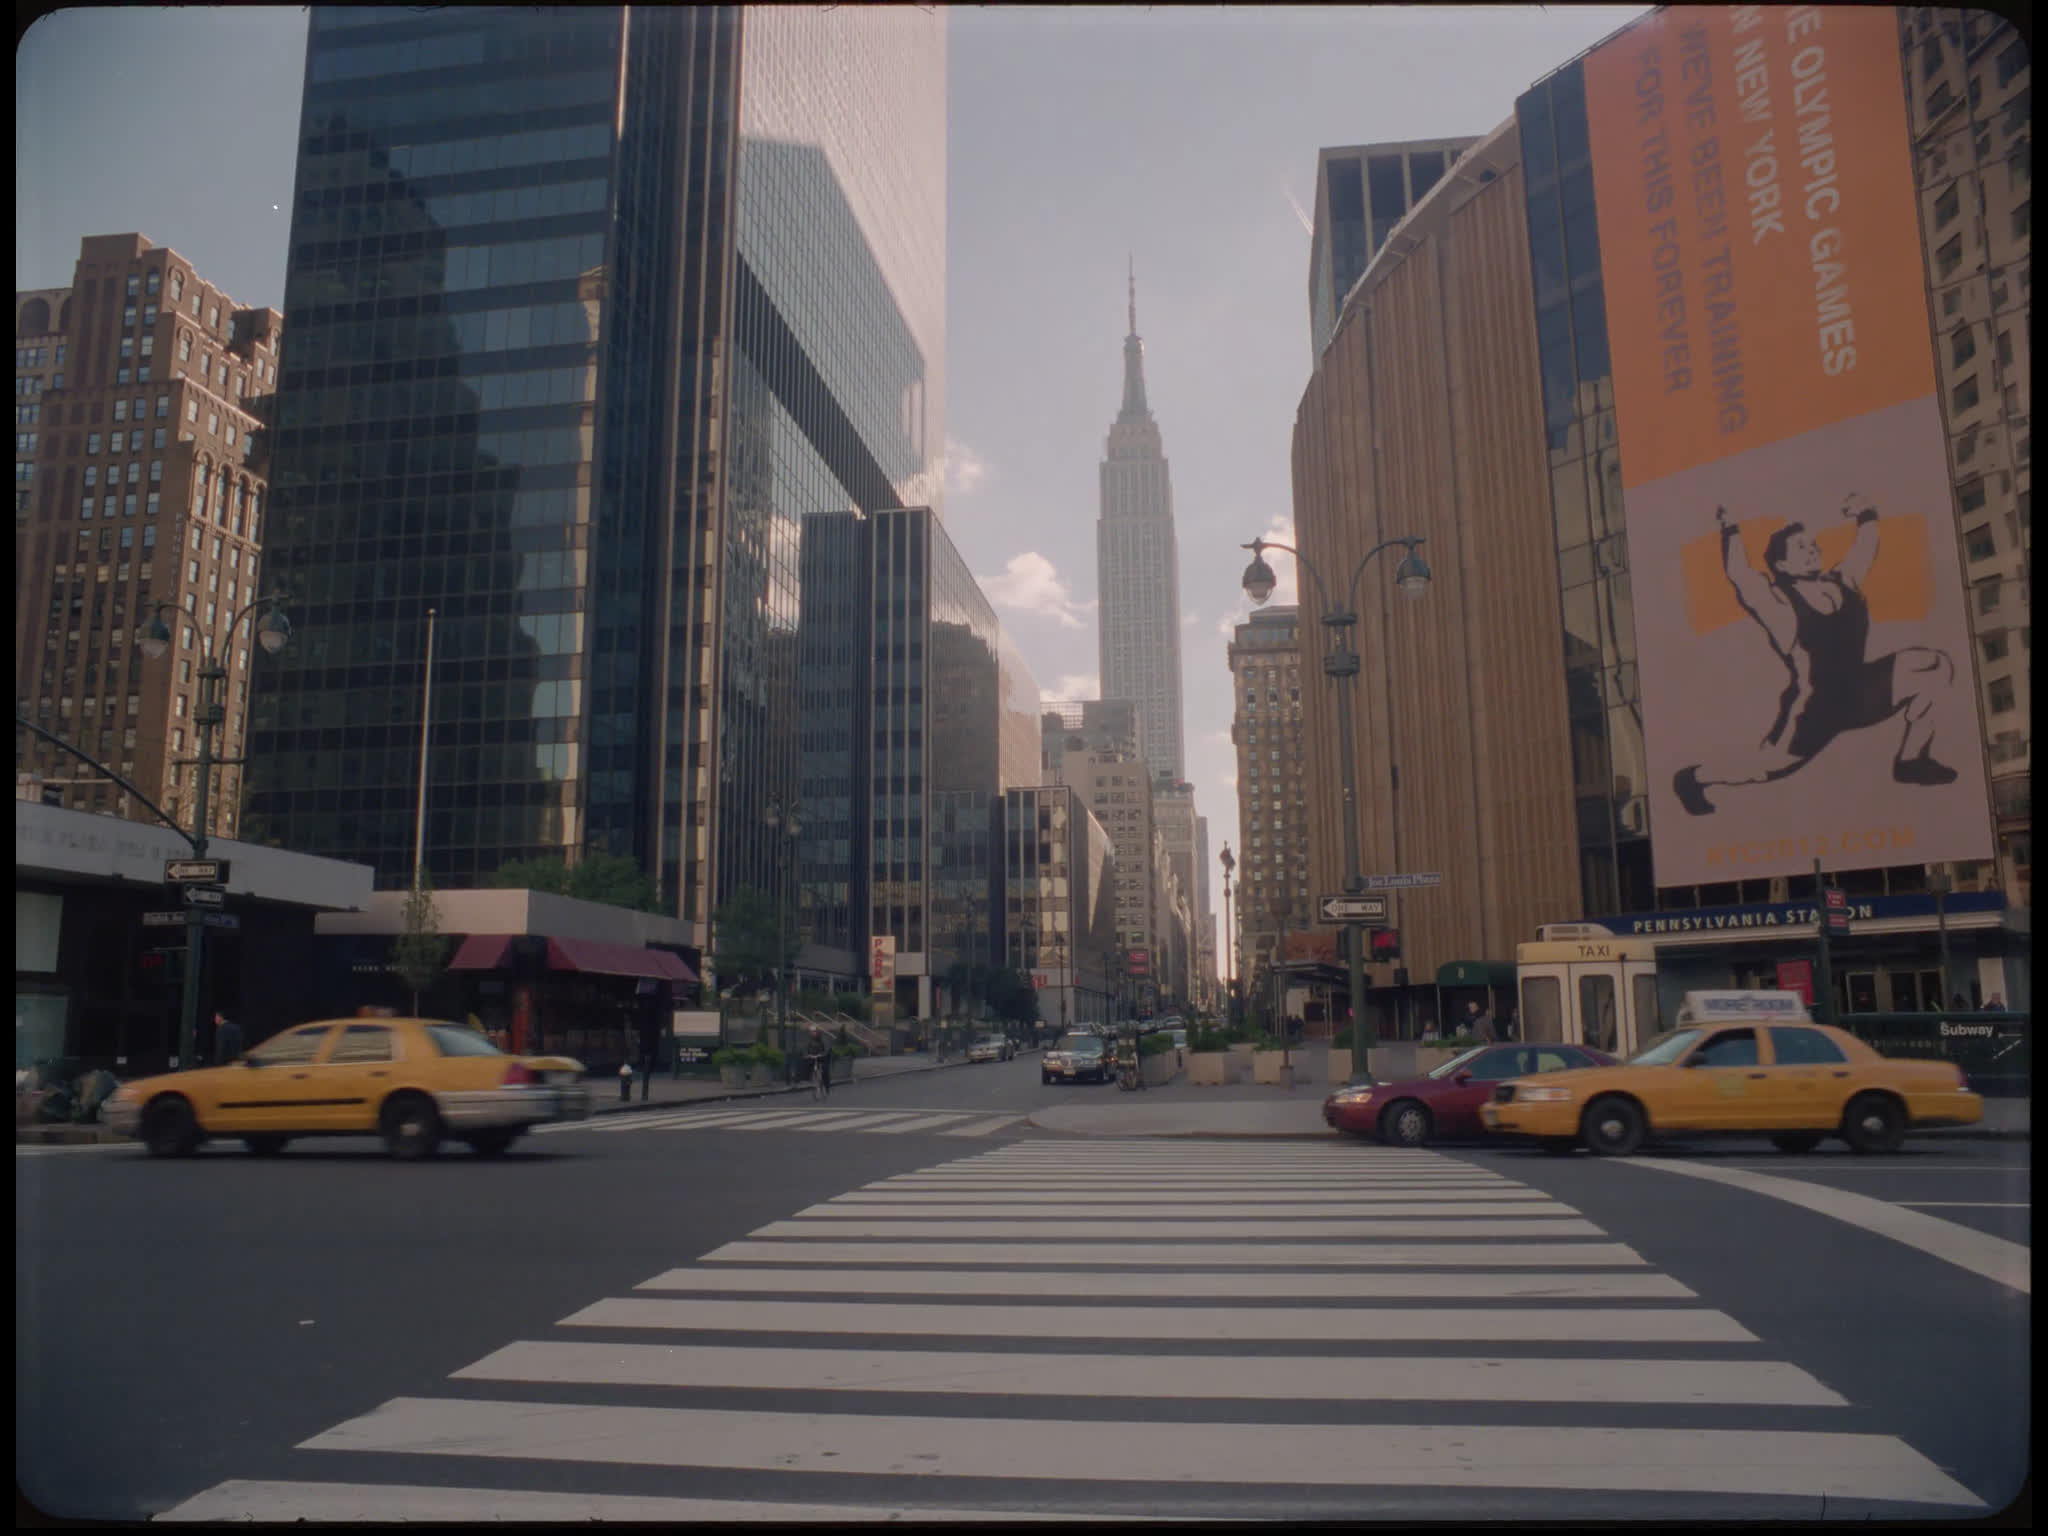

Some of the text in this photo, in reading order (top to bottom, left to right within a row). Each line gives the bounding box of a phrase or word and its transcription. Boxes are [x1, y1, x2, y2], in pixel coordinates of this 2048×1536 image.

[1733, 37, 1773, 124] NEW
[1791, 46, 1840, 220] OLYMPIC
[1632, 46, 1694, 397] FOR THIS FOREVER
[1688, 135, 1728, 242] BEEN
[1745, 127, 1786, 245] YORK
[1702, 241, 1748, 436] TRAINING
[1810, 227, 1857, 377] GAMES
[1707, 824, 1915, 866] NYC2012.COM
[1361, 902, 1380, 912] WAY
[1577, 945, 1610, 958] TAXI
[1633, 911, 1778, 933] PENNSYLVANIA
[1786, 904, 1873, 925] STAON
[1940, 1021, 1994, 1039] Subway
